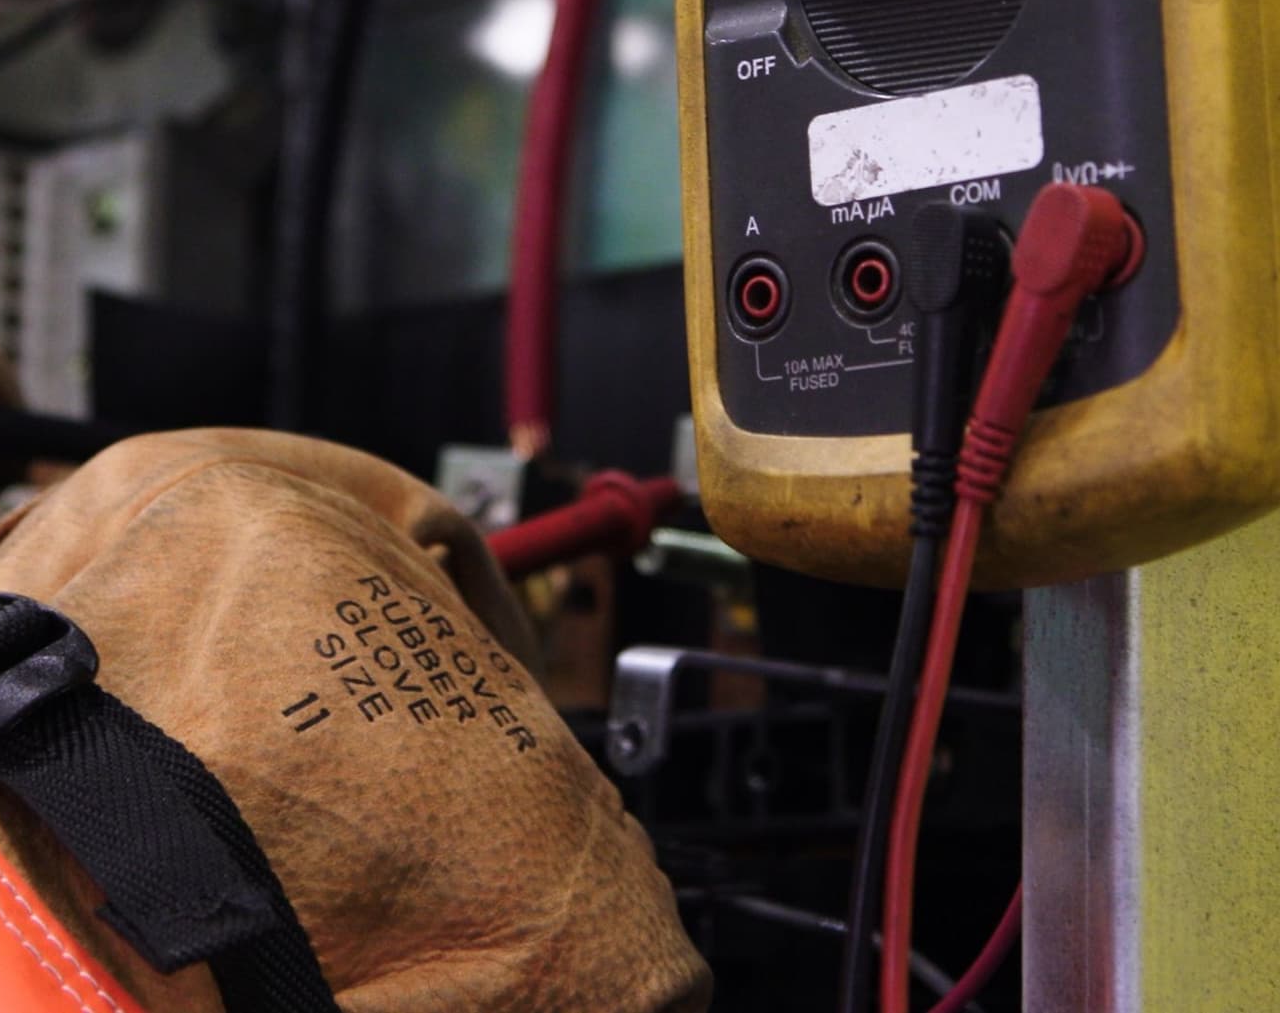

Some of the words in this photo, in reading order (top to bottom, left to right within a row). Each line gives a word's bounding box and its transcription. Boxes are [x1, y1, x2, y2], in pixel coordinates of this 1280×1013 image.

[737, 55, 776, 80] OFF
[949, 179, 1001, 206] COM
[746, 215, 761, 237] A
[832, 201, 864, 225] mA
[784, 358, 809, 375] 10A
[812, 353, 844, 371] MAX
[789, 371, 840, 392] FUSED
[335, 600, 441, 725] GLOVE
[357, 574, 476, 724] RUBBER
[314, 633, 393, 722] SIZE
[409, 595, 455, 640] AR
[453, 650, 536, 752] OVER
[282, 692, 331, 733] 11
